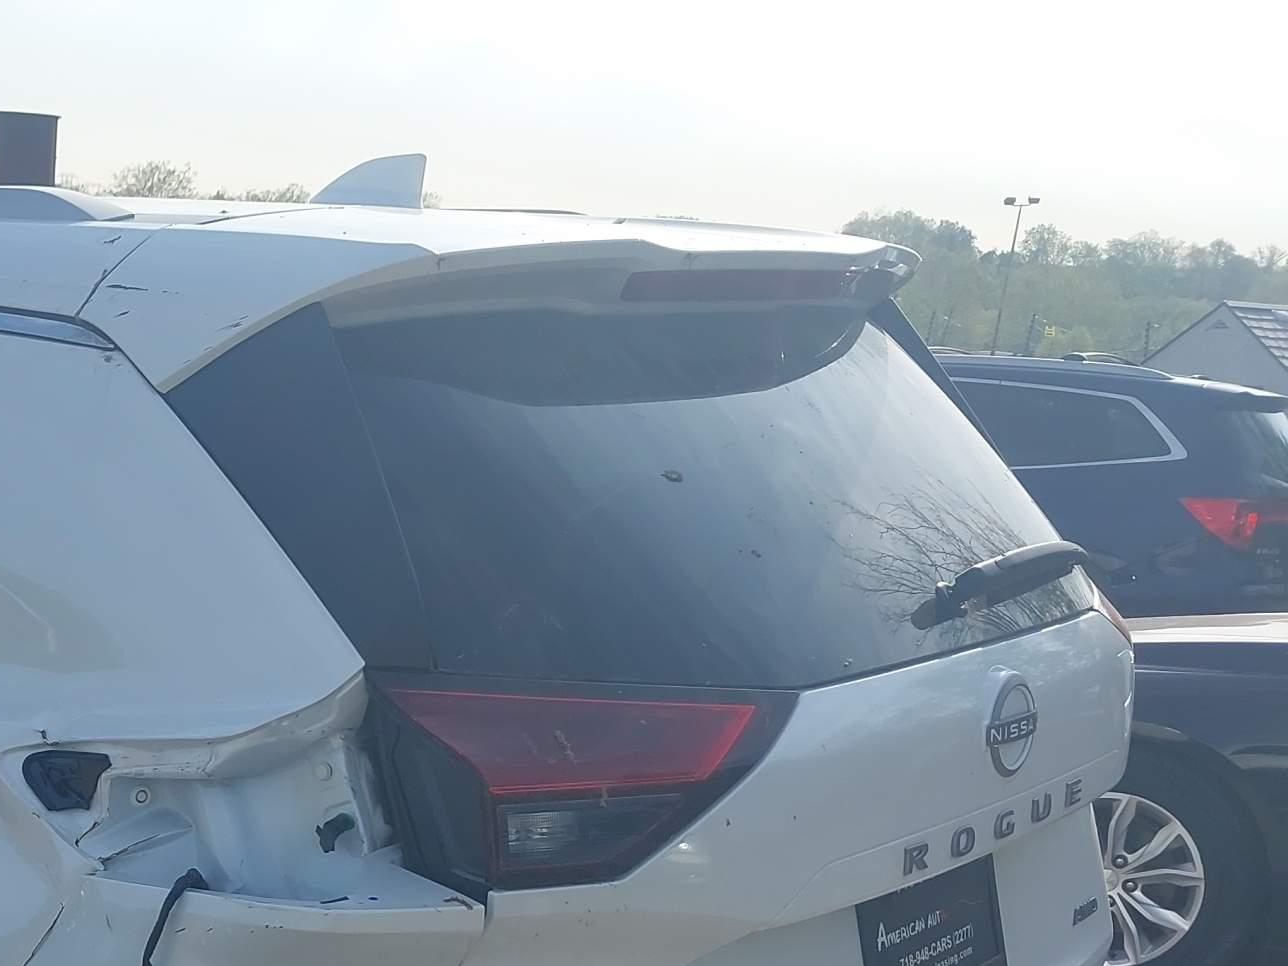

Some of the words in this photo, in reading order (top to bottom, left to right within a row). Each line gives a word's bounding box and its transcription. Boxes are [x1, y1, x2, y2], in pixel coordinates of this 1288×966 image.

[990, 718, 1034, 743] NISSA
[903, 778, 1082, 876] ROGUE
[876, 916, 925, 953] AMERICAN
[953, 922, 974, 946] (2277)
